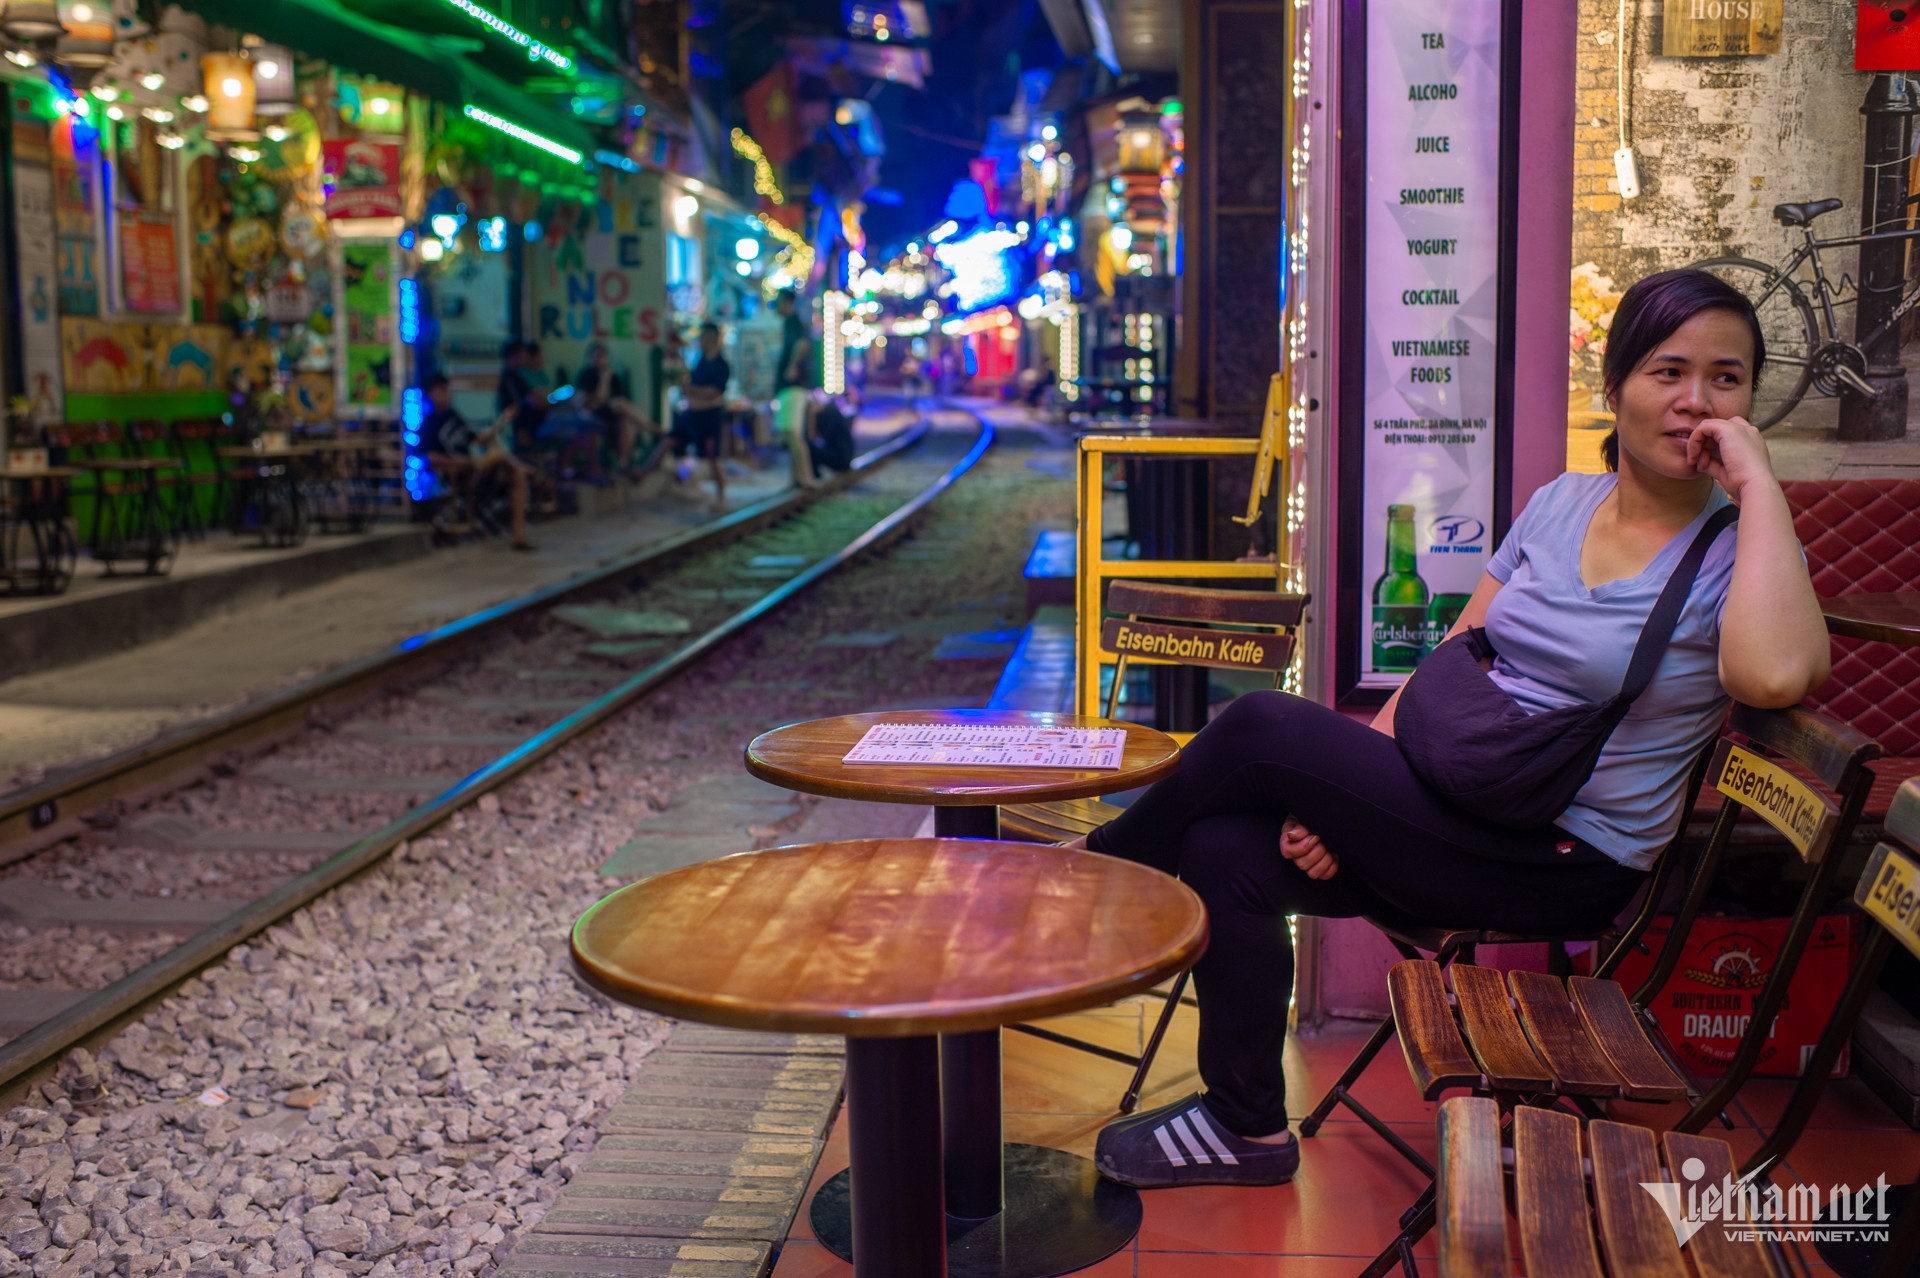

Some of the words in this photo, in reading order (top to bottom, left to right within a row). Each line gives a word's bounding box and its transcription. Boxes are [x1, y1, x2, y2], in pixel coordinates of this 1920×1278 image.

[1690, 0, 1764, 20] HOUSE
[1421, 33, 1445, 49] TEA
[1408, 84, 1458, 101] ALCOHO
[1415, 136, 1450, 153] JUICE
[1400, 187, 1465, 205] SMOOTHIE
[1407, 239, 1458, 256] YOGURT
[567, 270, 631, 307] NO
[1402, 289, 1460, 305] COCKTAIL
[540, 305, 660, 343] RULES
[1392, 340, 1470, 357] VIETNAMESE
[1411, 367, 1452, 383] FOODS
[1115, 626, 1215, 659] Eisenbahn
[1218, 638, 1264, 664] Kaffe
[1722, 754, 1795, 826] Eisenbahn
[1672, 992, 1742, 1010] SOUTHERN
[1684, 1013, 1780, 1039] DRAUGT
